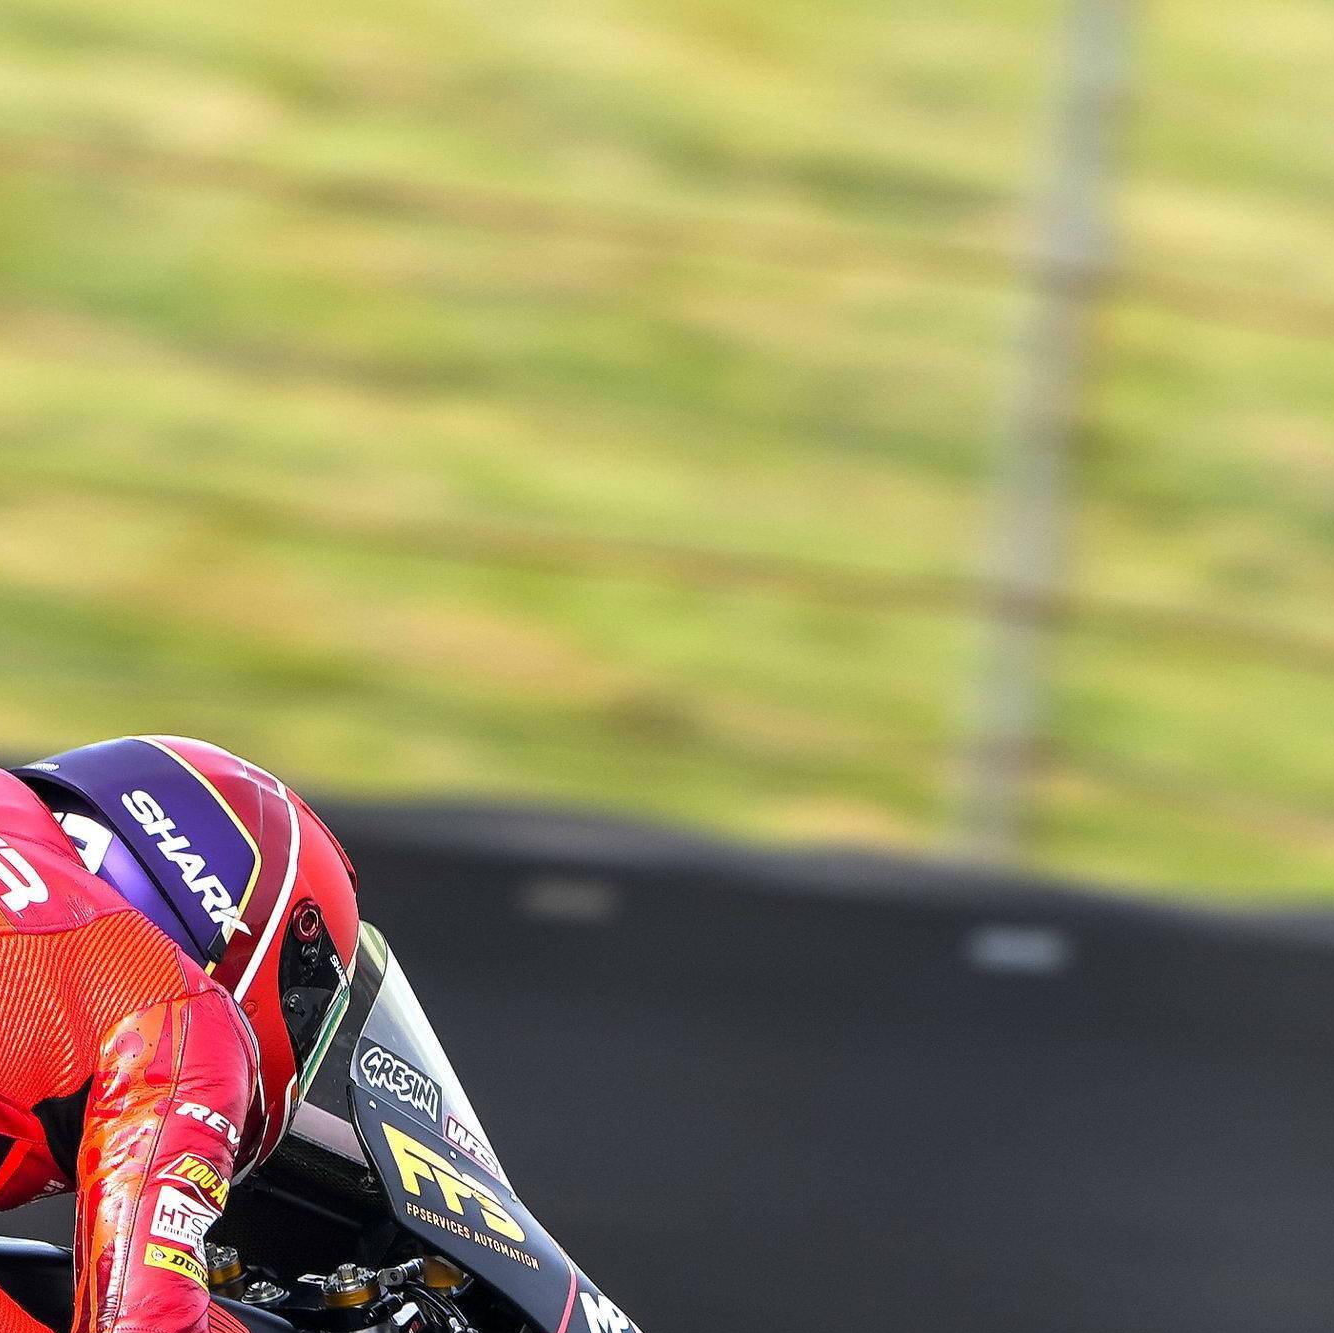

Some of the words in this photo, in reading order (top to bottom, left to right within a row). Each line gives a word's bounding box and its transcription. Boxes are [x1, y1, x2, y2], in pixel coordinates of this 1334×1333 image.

[121, 789, 253, 944] SHARK
[359, 1046, 439, 1123] GRESINI
[406, 1201, 471, 1239] FPSERVICES
[473, 1231, 540, 1271] AUTOMATION
